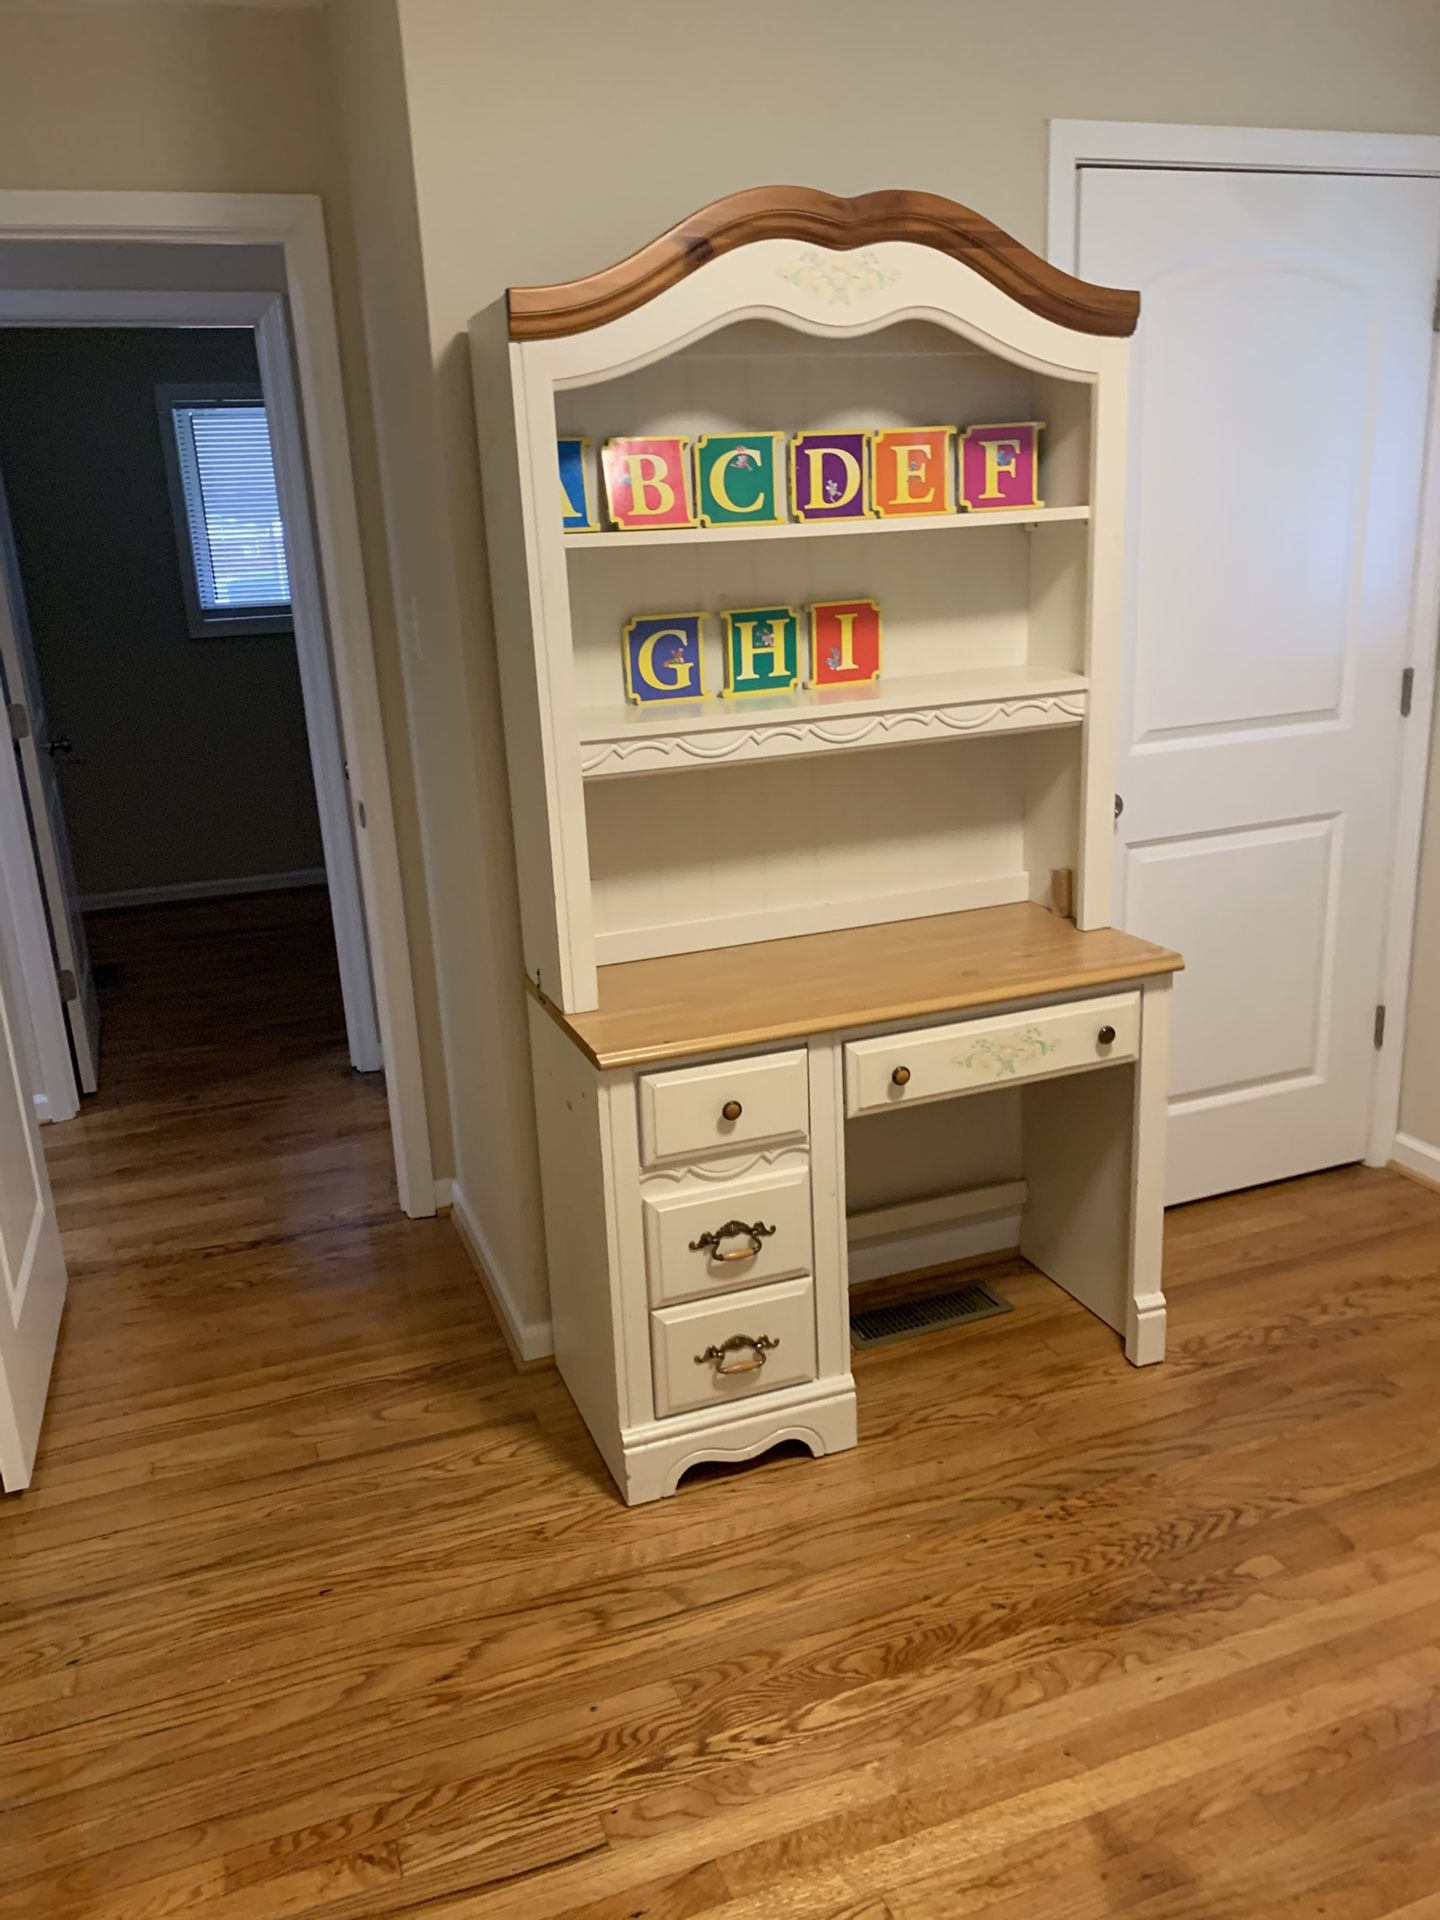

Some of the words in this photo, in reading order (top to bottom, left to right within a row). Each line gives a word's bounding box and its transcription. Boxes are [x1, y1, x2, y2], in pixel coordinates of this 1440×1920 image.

[624, 454, 675, 516] B
[709, 449, 765, 513] C
[804, 448, 861, 510] D
[889, 444, 935, 505] E
[978, 440, 1021, 499] F
[638, 629, 694, 690] G
[735, 618, 791, 681] H
[835, 613, 859, 671] I
